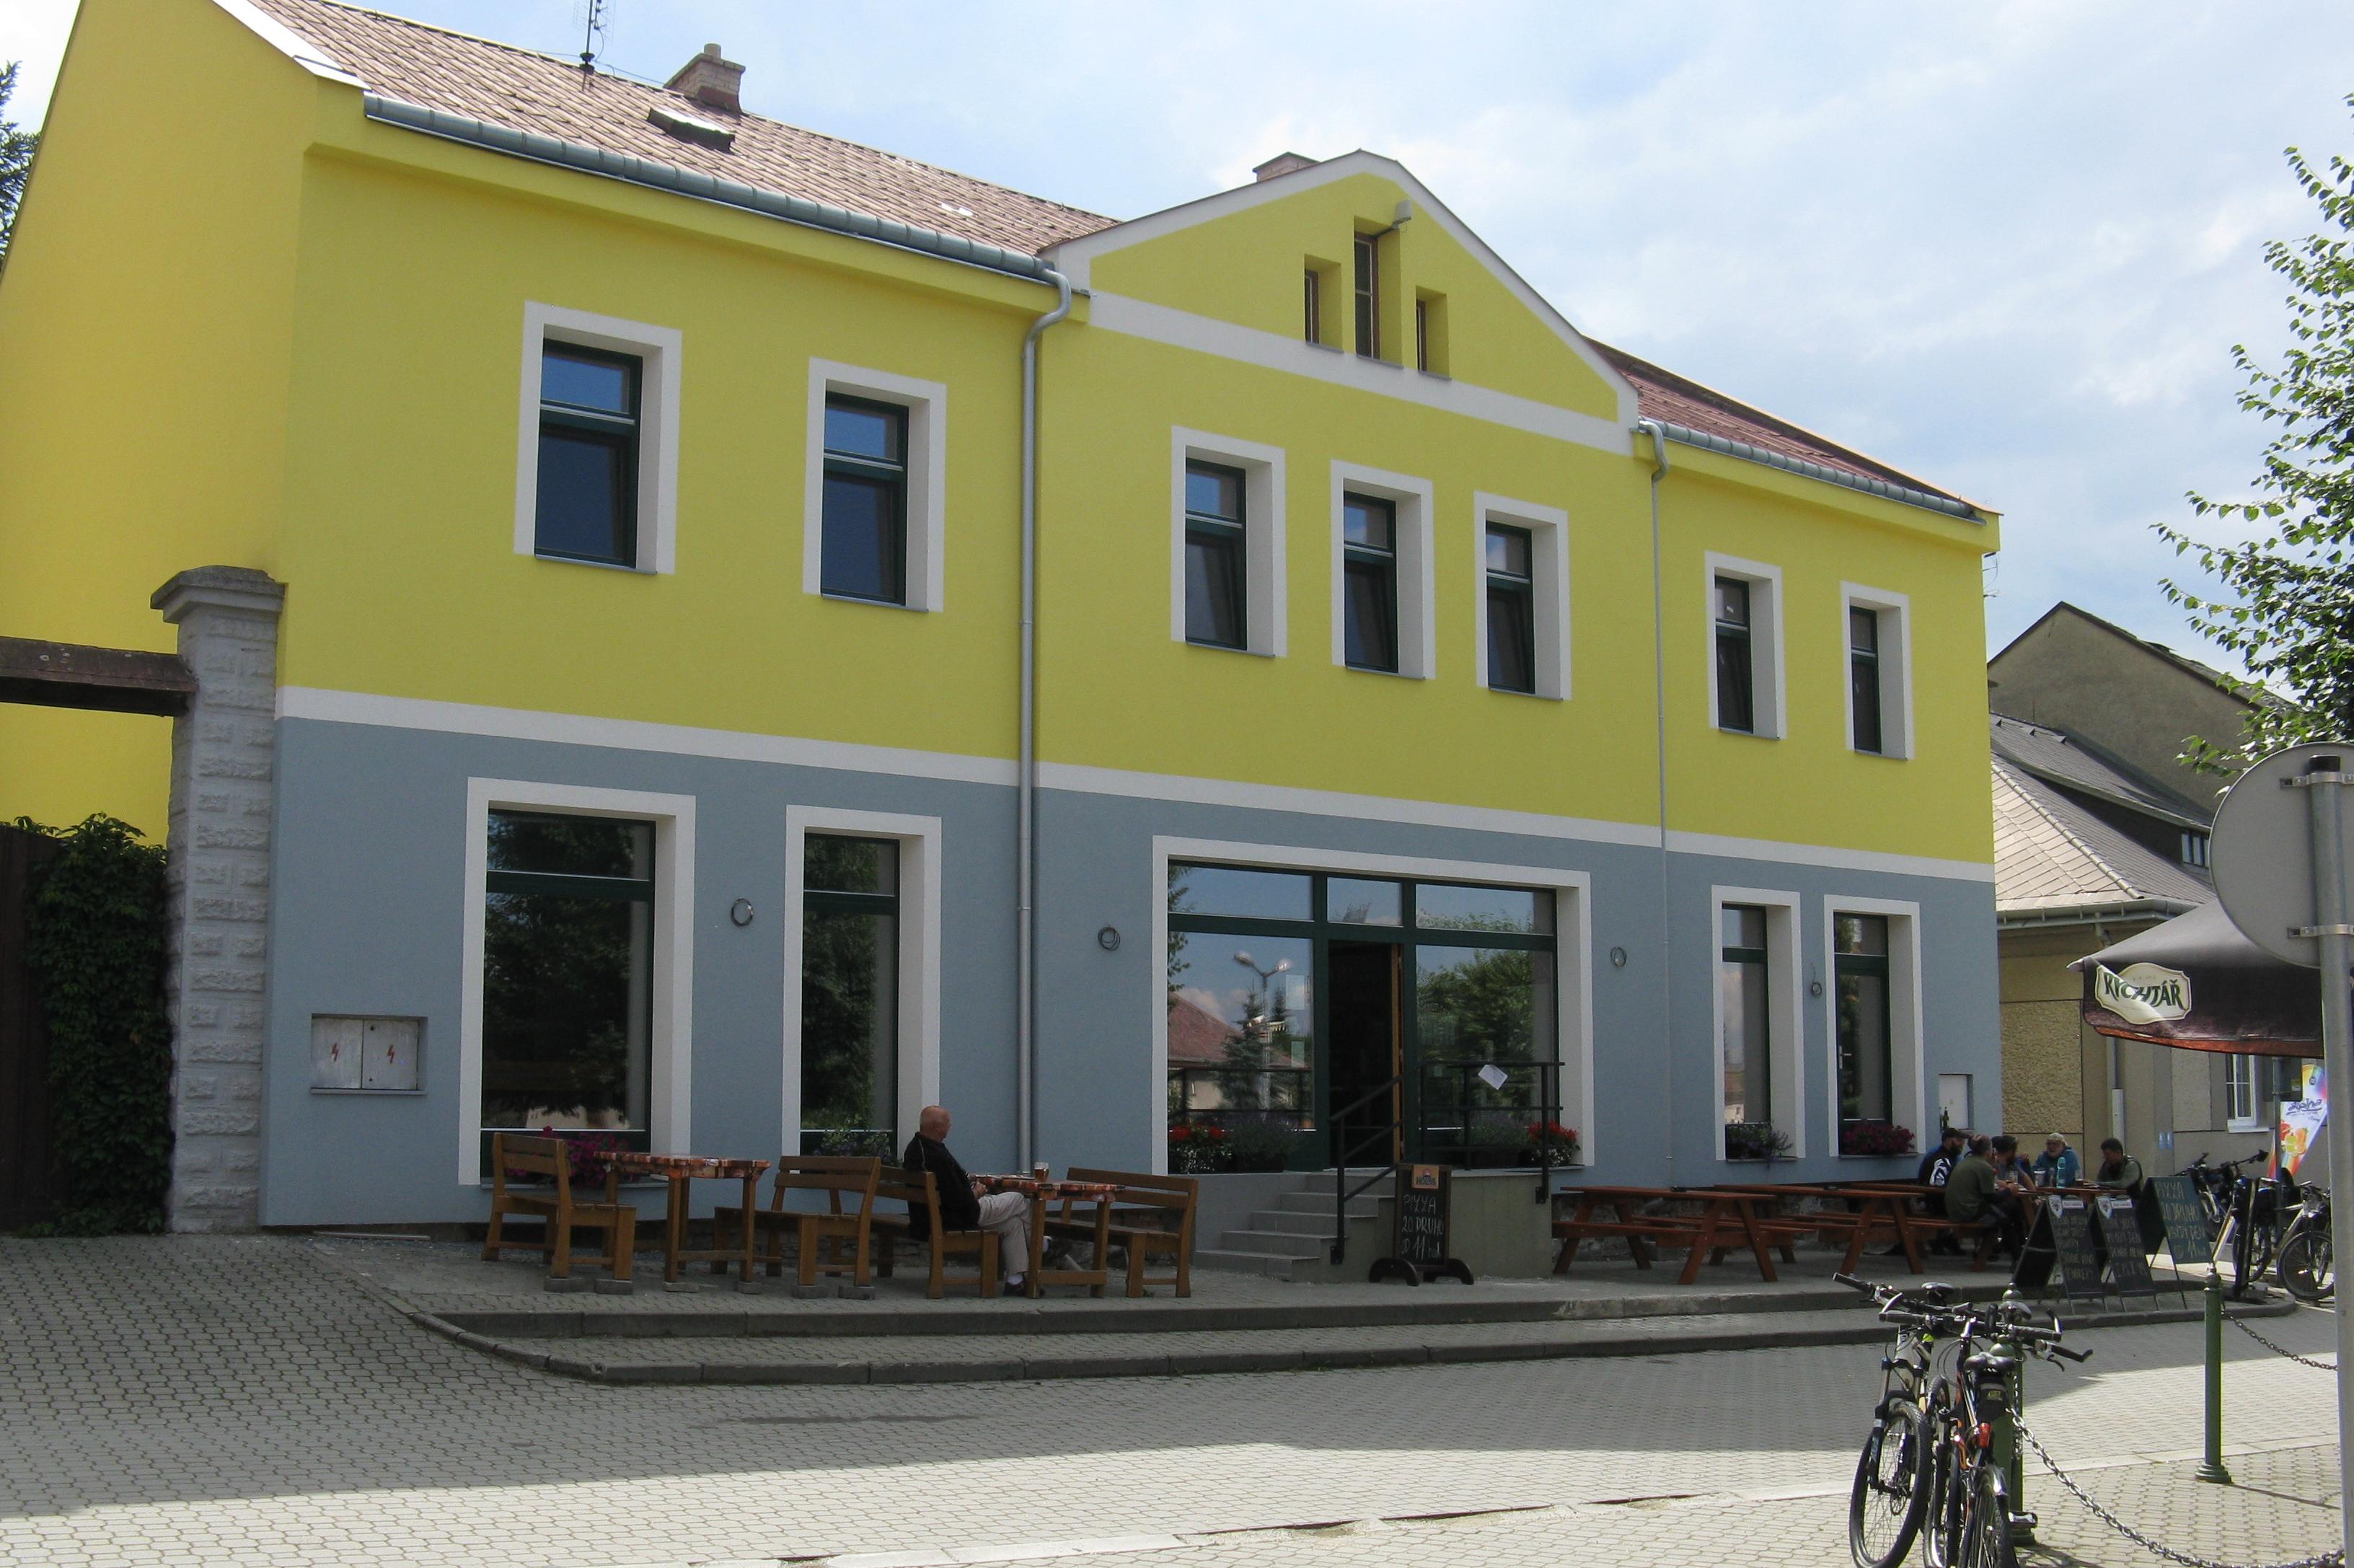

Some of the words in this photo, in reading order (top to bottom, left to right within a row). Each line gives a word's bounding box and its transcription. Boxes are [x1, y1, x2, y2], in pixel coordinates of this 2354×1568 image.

[2103, 972, 2187, 1011] RYCHTÁŘ
[1403, 1194, 1436, 1215] PIZZA
[1401, 1216, 1414, 1233] 20
[1413, 1234, 1425, 1259] 11
